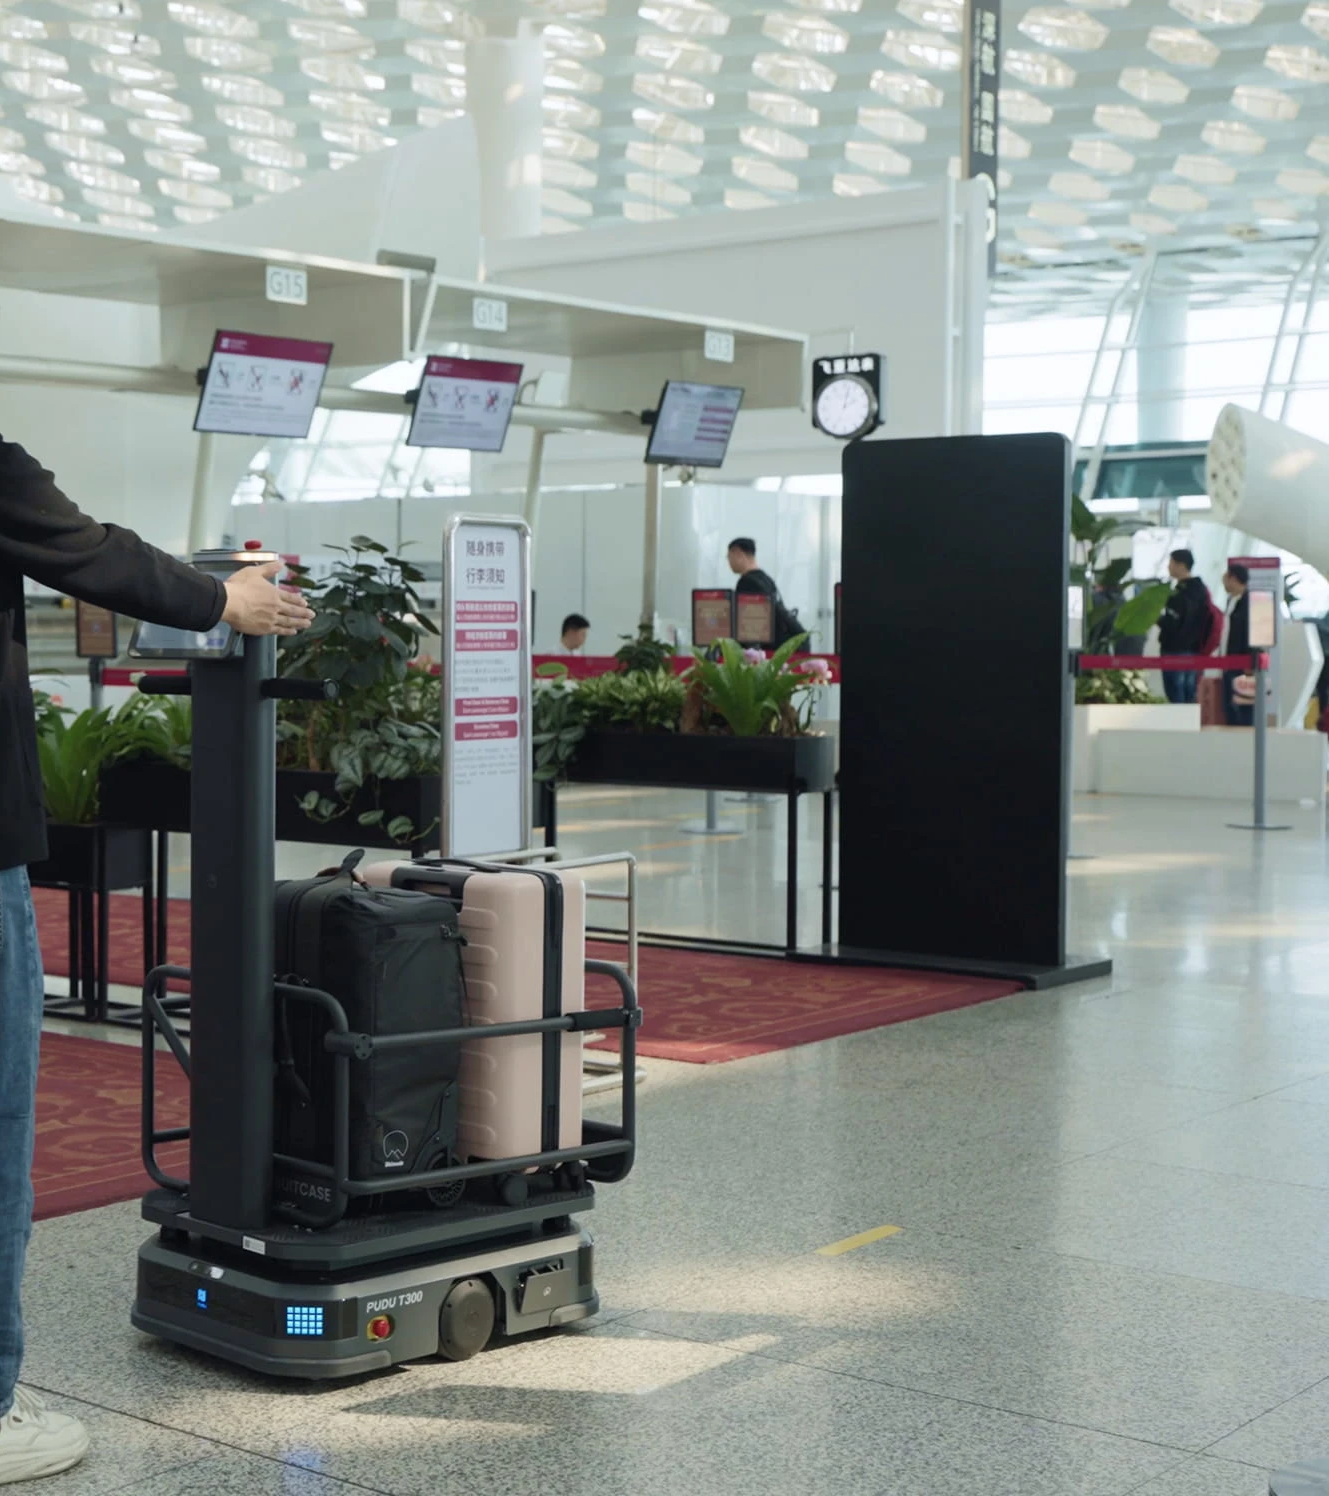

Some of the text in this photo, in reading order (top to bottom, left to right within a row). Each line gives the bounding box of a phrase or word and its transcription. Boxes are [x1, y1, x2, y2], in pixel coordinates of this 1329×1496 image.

[270, 270, 304, 298] G15
[475, 300, 504, 325] G14
[366, 1290, 424, 1314] PUDU T300
